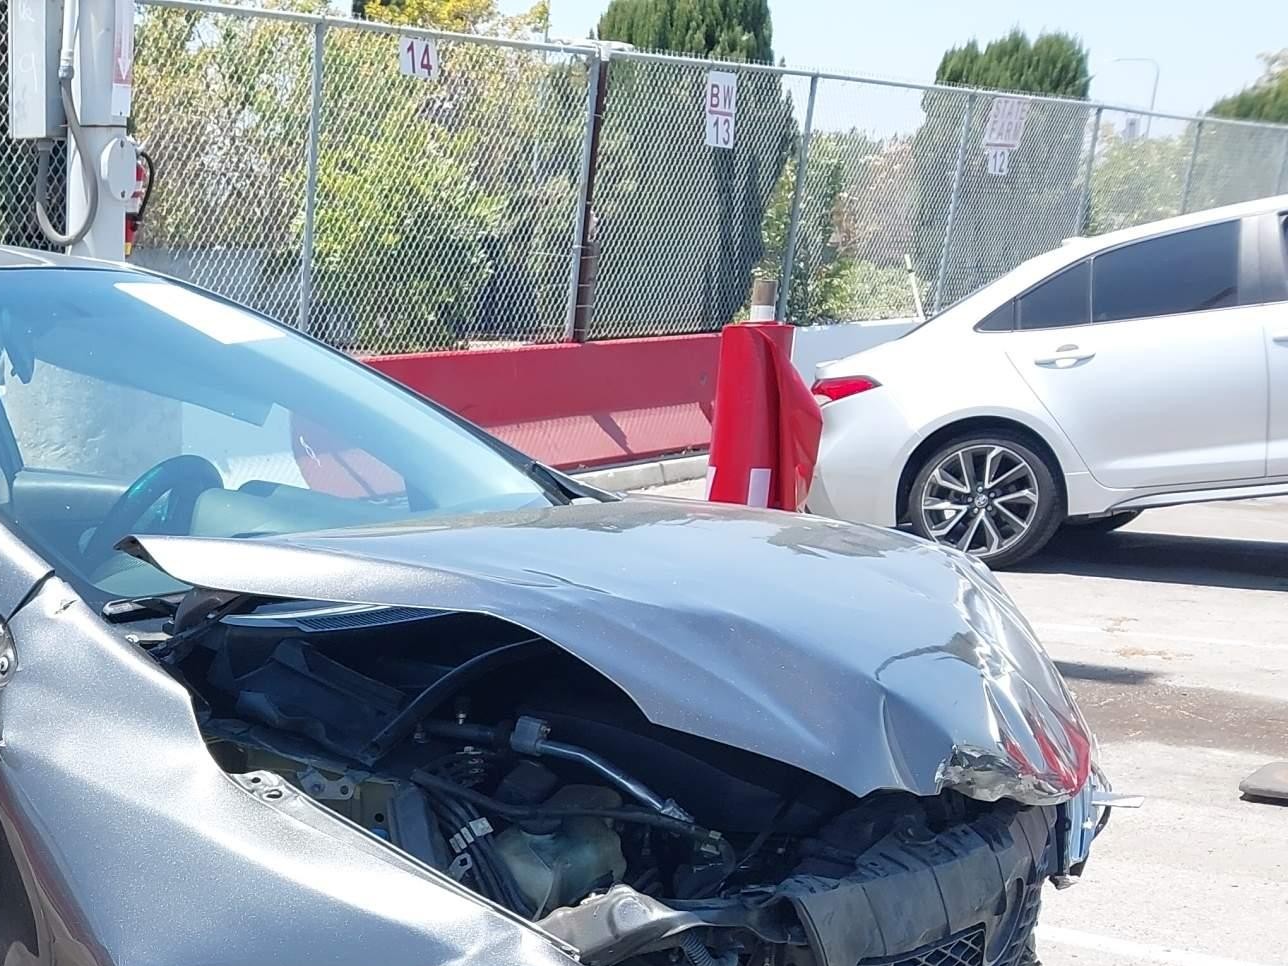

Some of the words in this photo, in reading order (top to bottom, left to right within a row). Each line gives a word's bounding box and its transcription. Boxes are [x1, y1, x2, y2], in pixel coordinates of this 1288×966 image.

[407, 41, 433, 77] 14
[712, 116, 731, 146] 13
[992, 150, 1006, 174] 12
